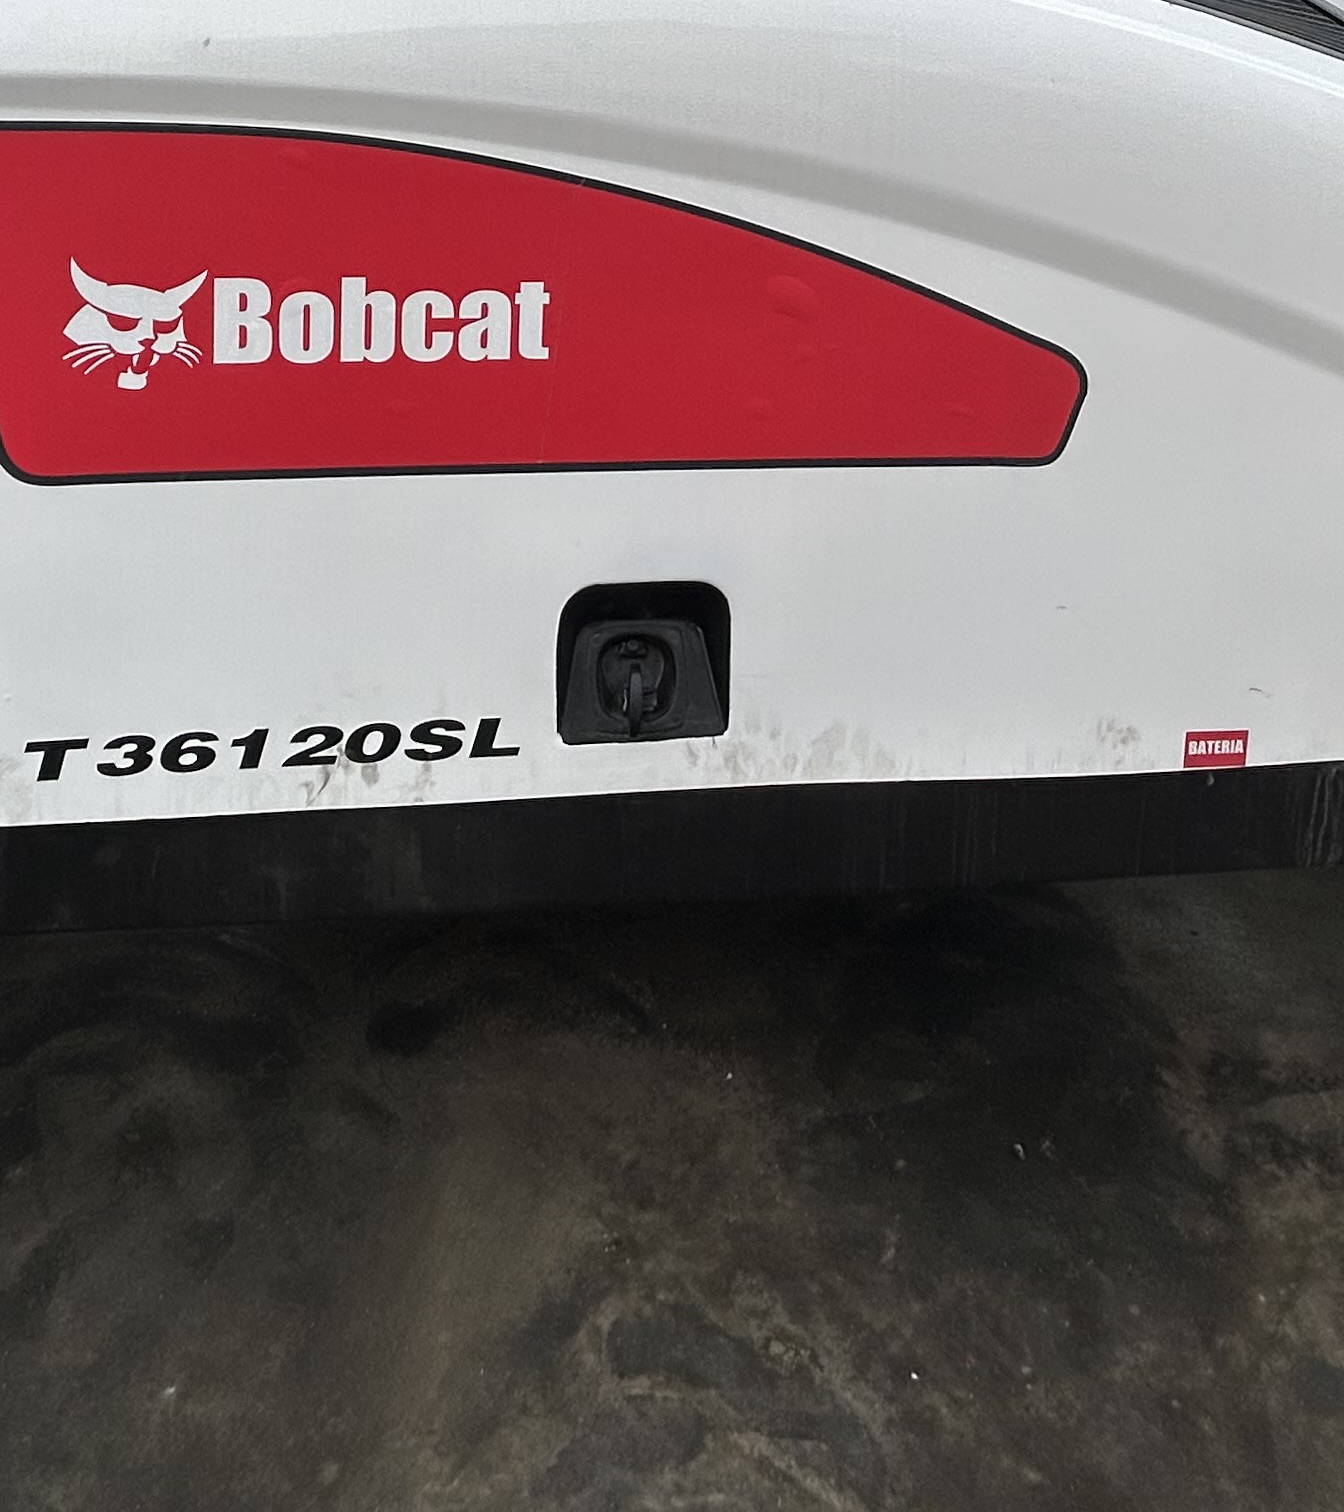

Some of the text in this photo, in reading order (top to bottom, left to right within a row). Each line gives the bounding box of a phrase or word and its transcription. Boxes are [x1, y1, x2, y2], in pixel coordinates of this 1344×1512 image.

[213, 276, 551, 365] Bobcat
[23, 717, 521, 782] T36120SL
[1188, 738, 1244, 756] BATERIA
